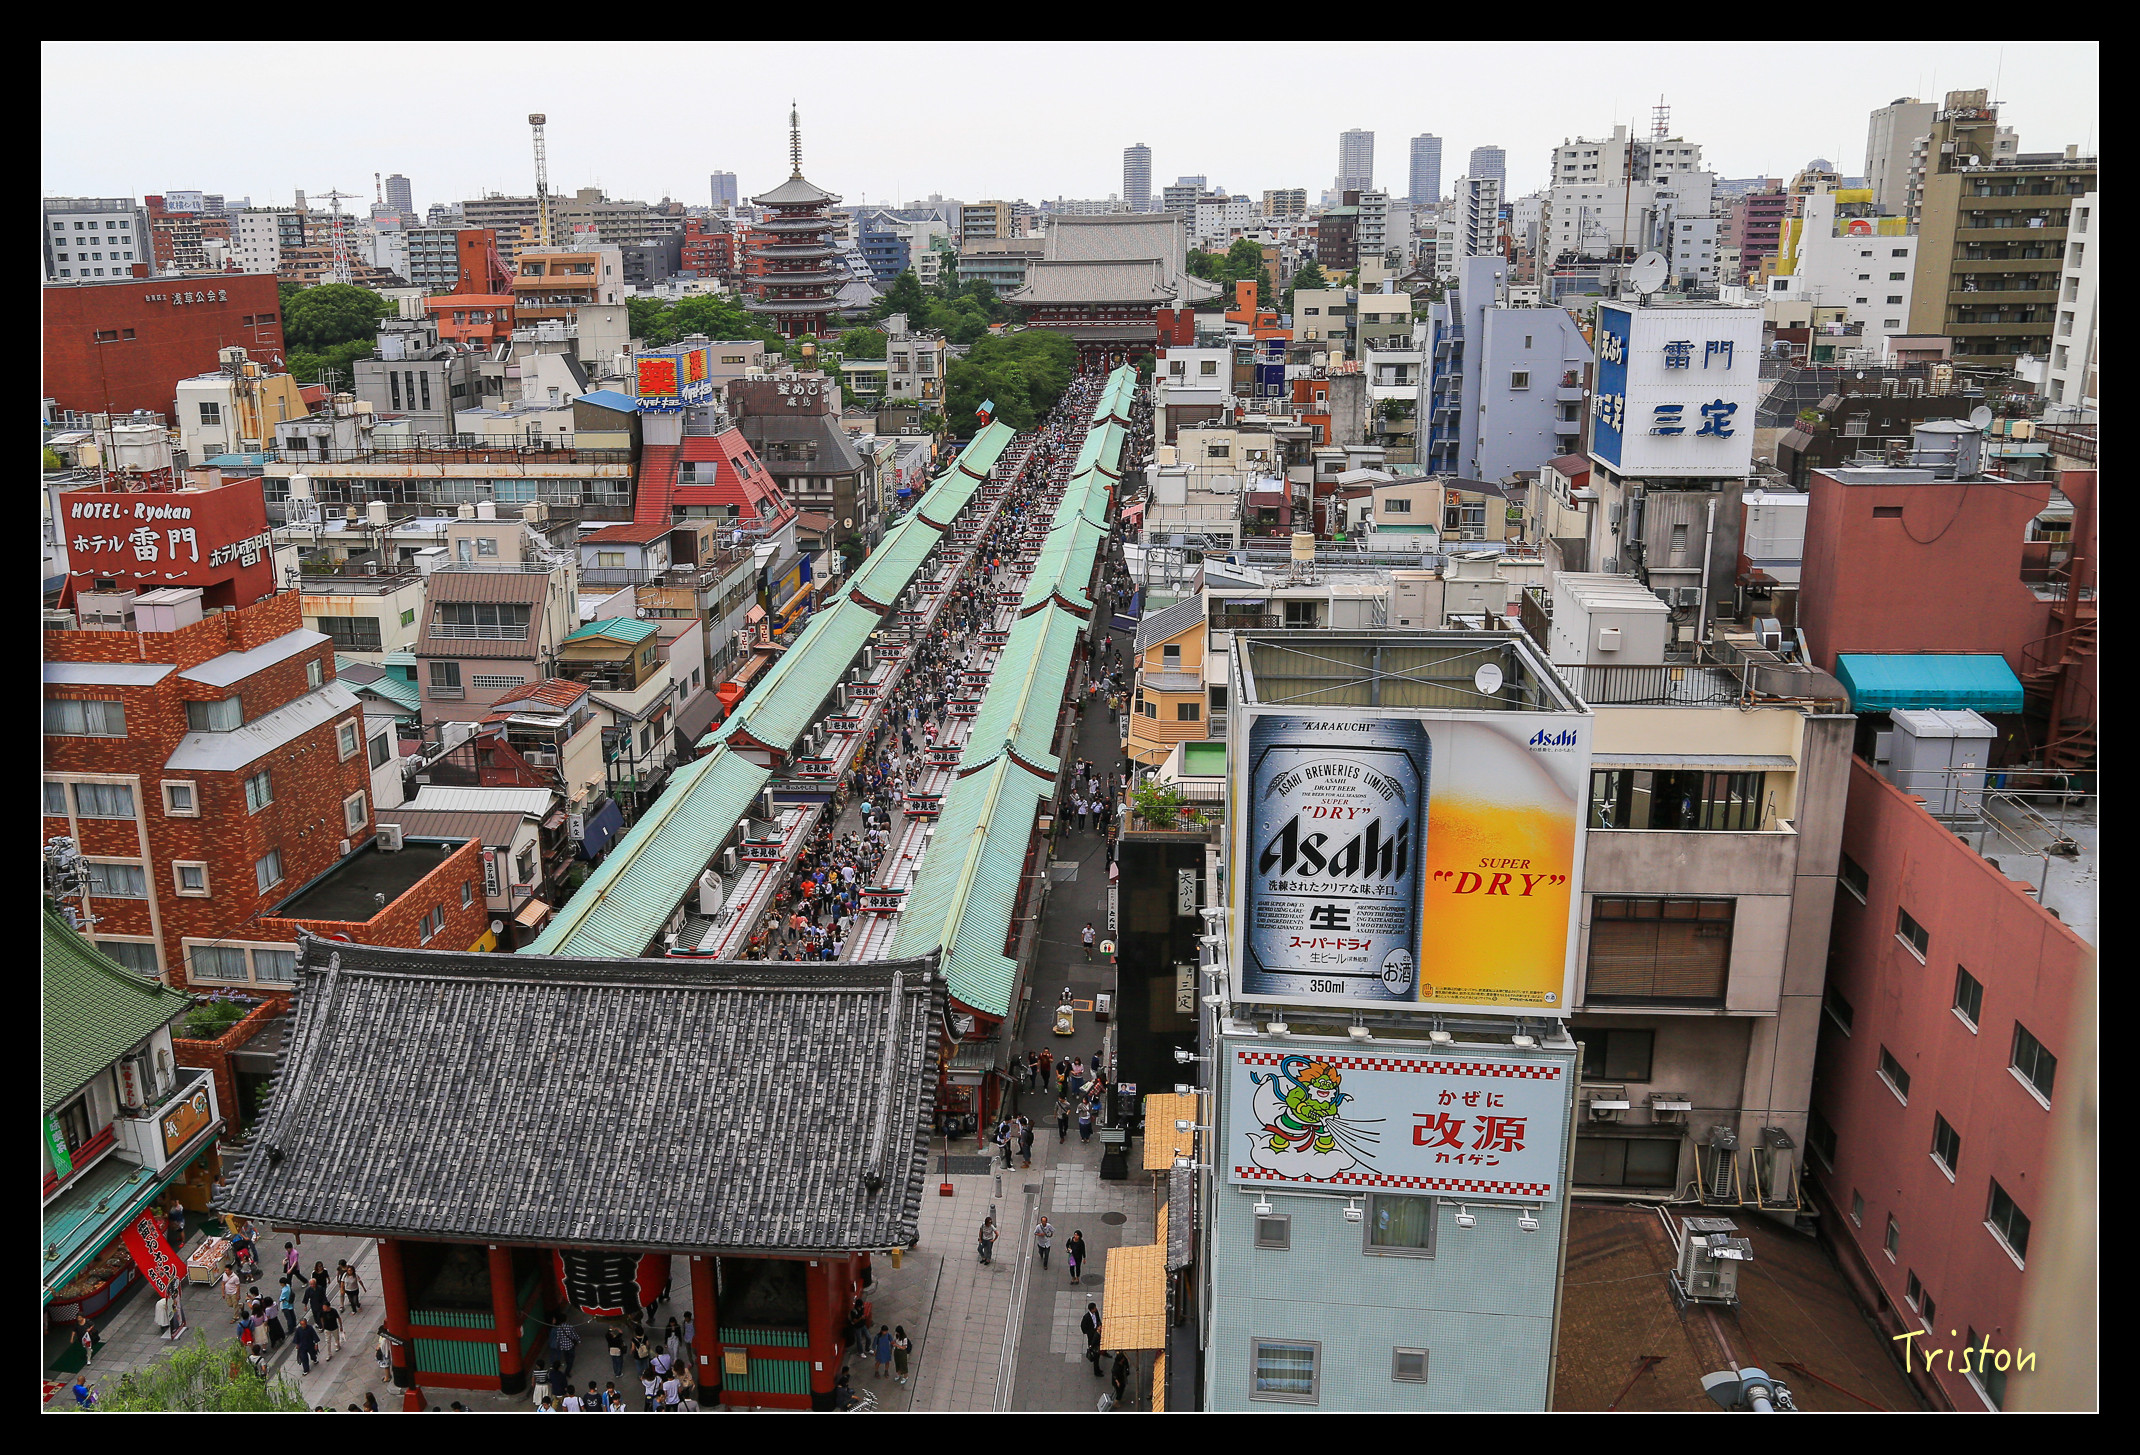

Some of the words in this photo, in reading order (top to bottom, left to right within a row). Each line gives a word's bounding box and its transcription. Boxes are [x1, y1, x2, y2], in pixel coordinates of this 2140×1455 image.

[172, 289, 227, 306] 浅草公会堂
[690, 350, 702, 381] 薬
[1663, 340, 1734, 370] 雷門
[638, 361, 676, 394] 薬
[1649, 399, 1738, 439] 三定
[134, 503, 191, 522] Ryokan
[1529, 729, 1577, 746] Asahi
[1277, 773, 1302, 797] ASAHI
[1305, 764, 1360, 780] BREWERIES
[1363, 772, 1394, 801] LIMITED
[1259, 813, 1409, 882] Asahi
[1479, 858, 1531, 869] SUPER
[1180, 873, 1193, 911] 天ぷら
[1268, 880, 1398, 896] 洗練されたクリアな味、辛口。
[1309, 904, 1351, 931] 生
[1289, 936, 1372, 951] スーパードライ
[1310, 952, 1347, 964] 生ビール
[1384, 962, 1412, 983] お酒
[1178, 982, 1192, 1009] 三定
[1310, 979, 1345, 993] 350ml
[1438, 1090, 1504, 1107] かぜに
[1412, 1112, 1528, 1152] 改源
[1435, 1152, 1500, 1166] カイゲン
